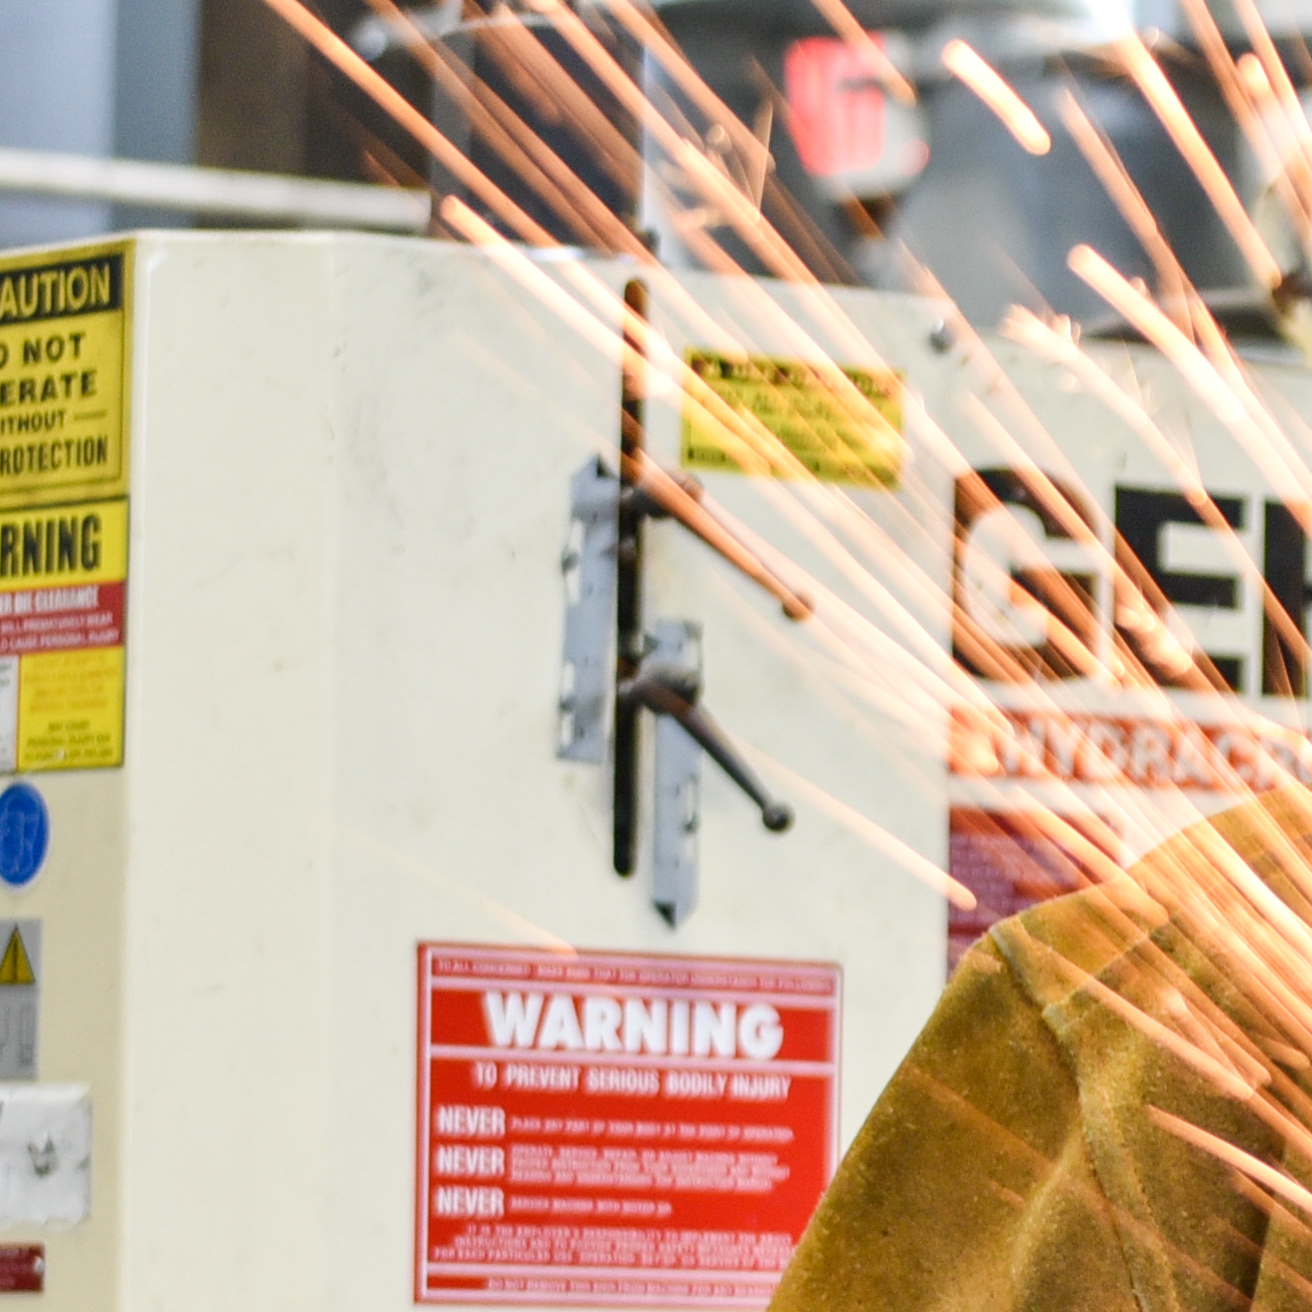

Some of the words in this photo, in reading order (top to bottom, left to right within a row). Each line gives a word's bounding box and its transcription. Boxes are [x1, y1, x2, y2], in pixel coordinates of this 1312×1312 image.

[22, 331, 86, 366] NOT
[484, 990, 784, 1061] WARNING
[474, 1061, 498, 1088] TO
[506, 1063, 581, 1091] PREVENT
[587, 1067, 660, 1096] SERIOUS
[667, 1071, 728, 1100] BODILY
[731, 1074, 792, 1102] INJURY
[437, 1106, 506, 1138] NEVER
[437, 1146, 505, 1178] NEVER
[436, 1186, 505, 1218] NEVER
